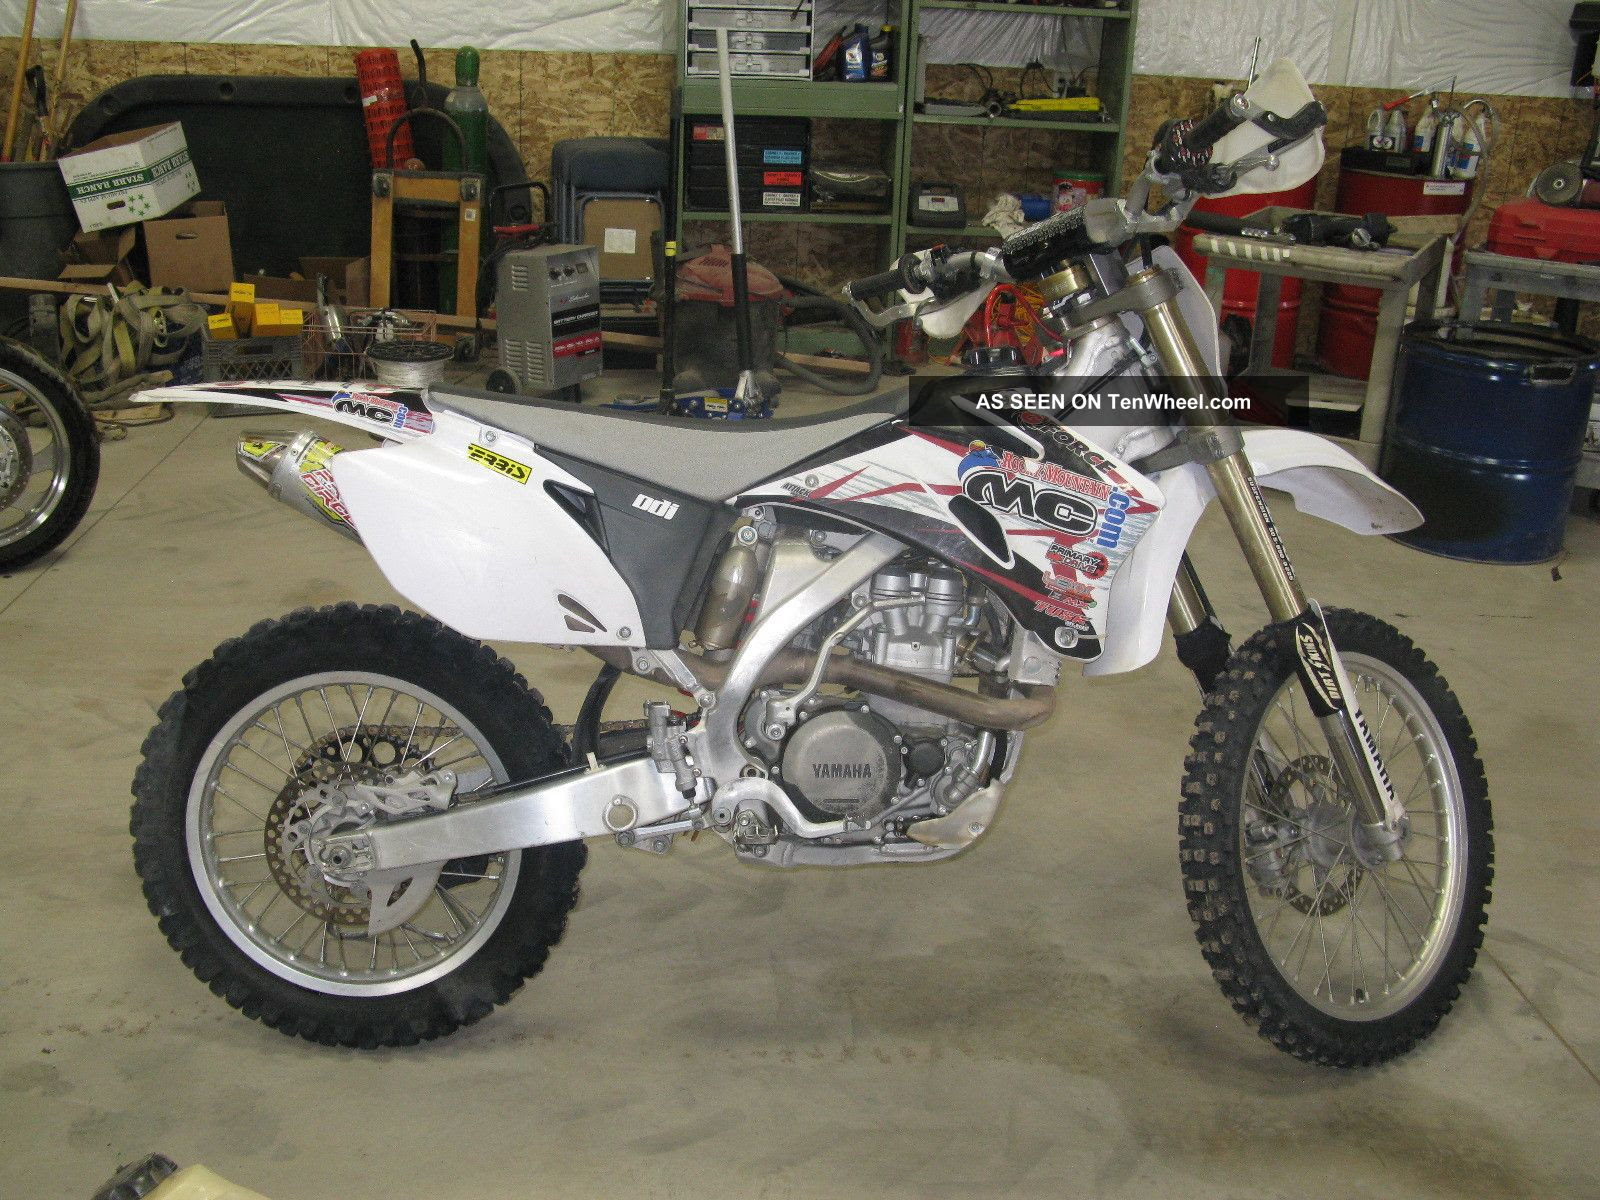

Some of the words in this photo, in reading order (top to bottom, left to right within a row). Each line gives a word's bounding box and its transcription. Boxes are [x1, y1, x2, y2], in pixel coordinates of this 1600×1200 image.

[76, 181, 111, 195] RANCH
[113, 173, 145, 185] STARR
[334, 399, 394, 423] MC
[962, 468, 1098, 537] MC
[1050, 543, 1101, 566] PRIMARY
[1064, 557, 1098, 574] DRIVE
[1354, 707, 1395, 801] YAMAHA
[812, 763, 872, 779] YAMAHA
